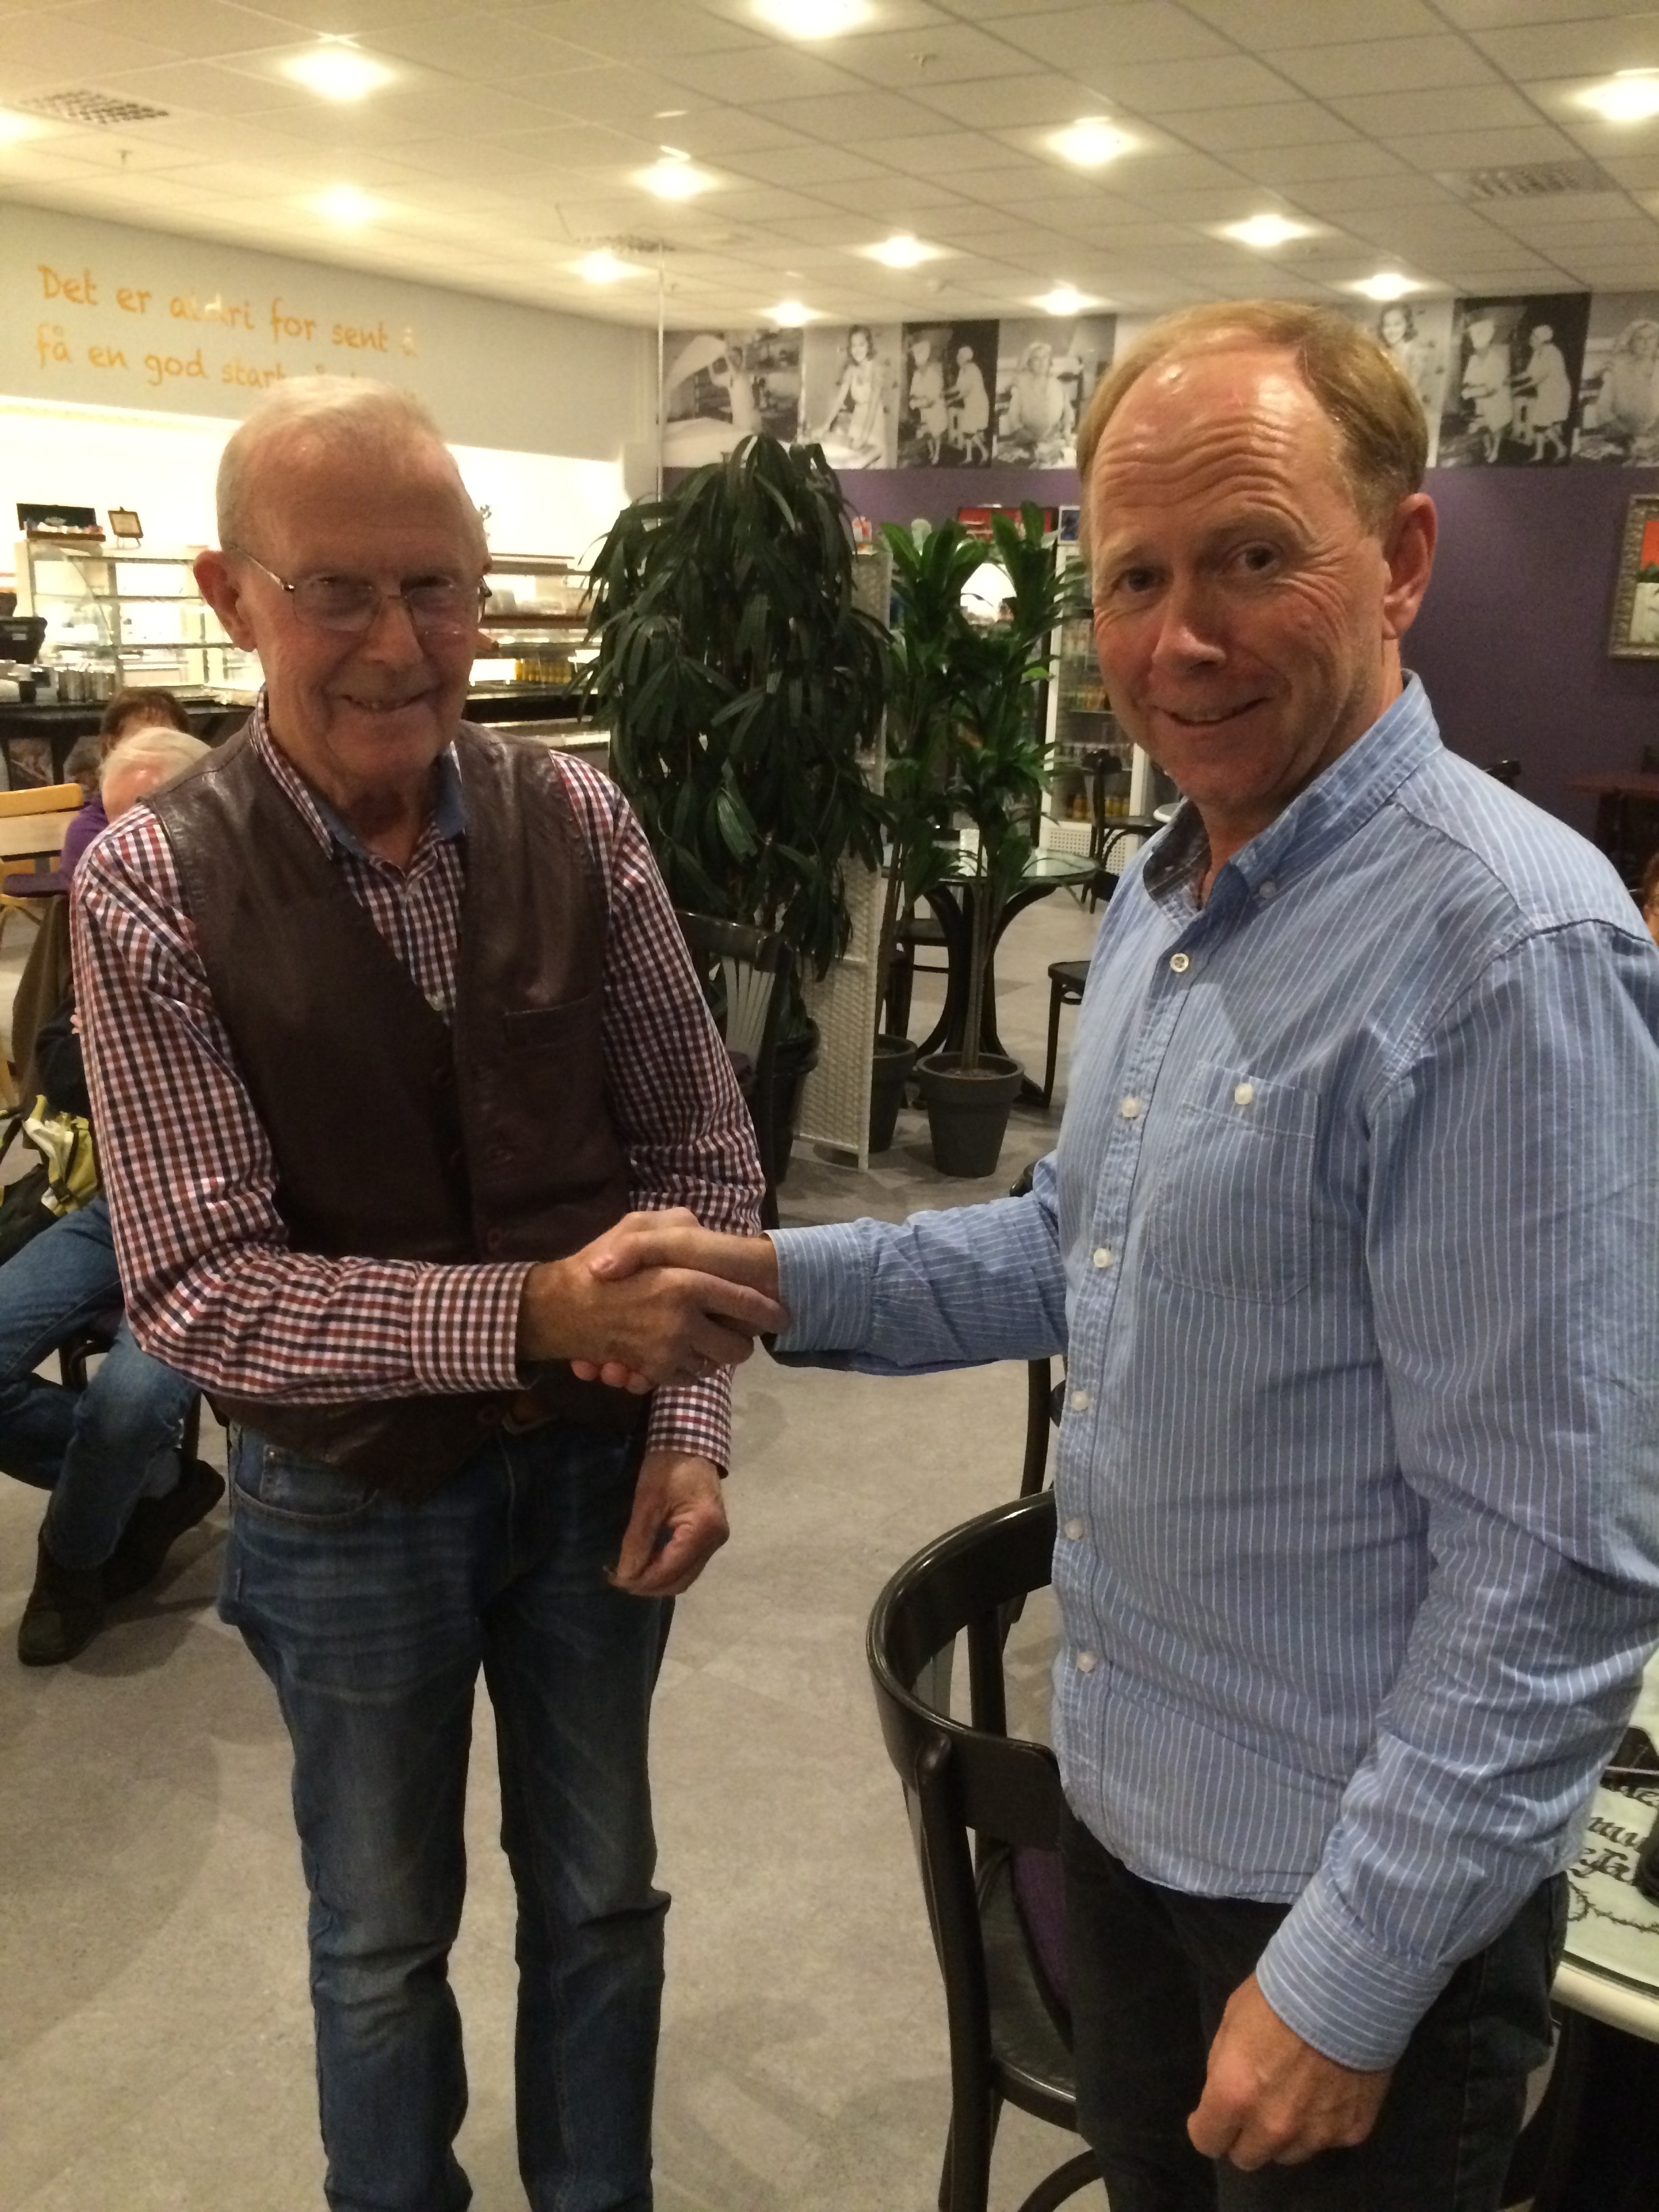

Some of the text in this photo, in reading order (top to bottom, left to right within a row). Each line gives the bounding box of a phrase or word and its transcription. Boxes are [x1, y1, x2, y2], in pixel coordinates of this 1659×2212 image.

[37, 264, 98, 306] Det
[117, 287, 152, 314] er
[270, 297, 316, 342] for
[331, 321, 389, 352] sent
[37, 323, 72, 369] få
[88, 346, 129, 370] en
[144, 348, 209, 386] god
